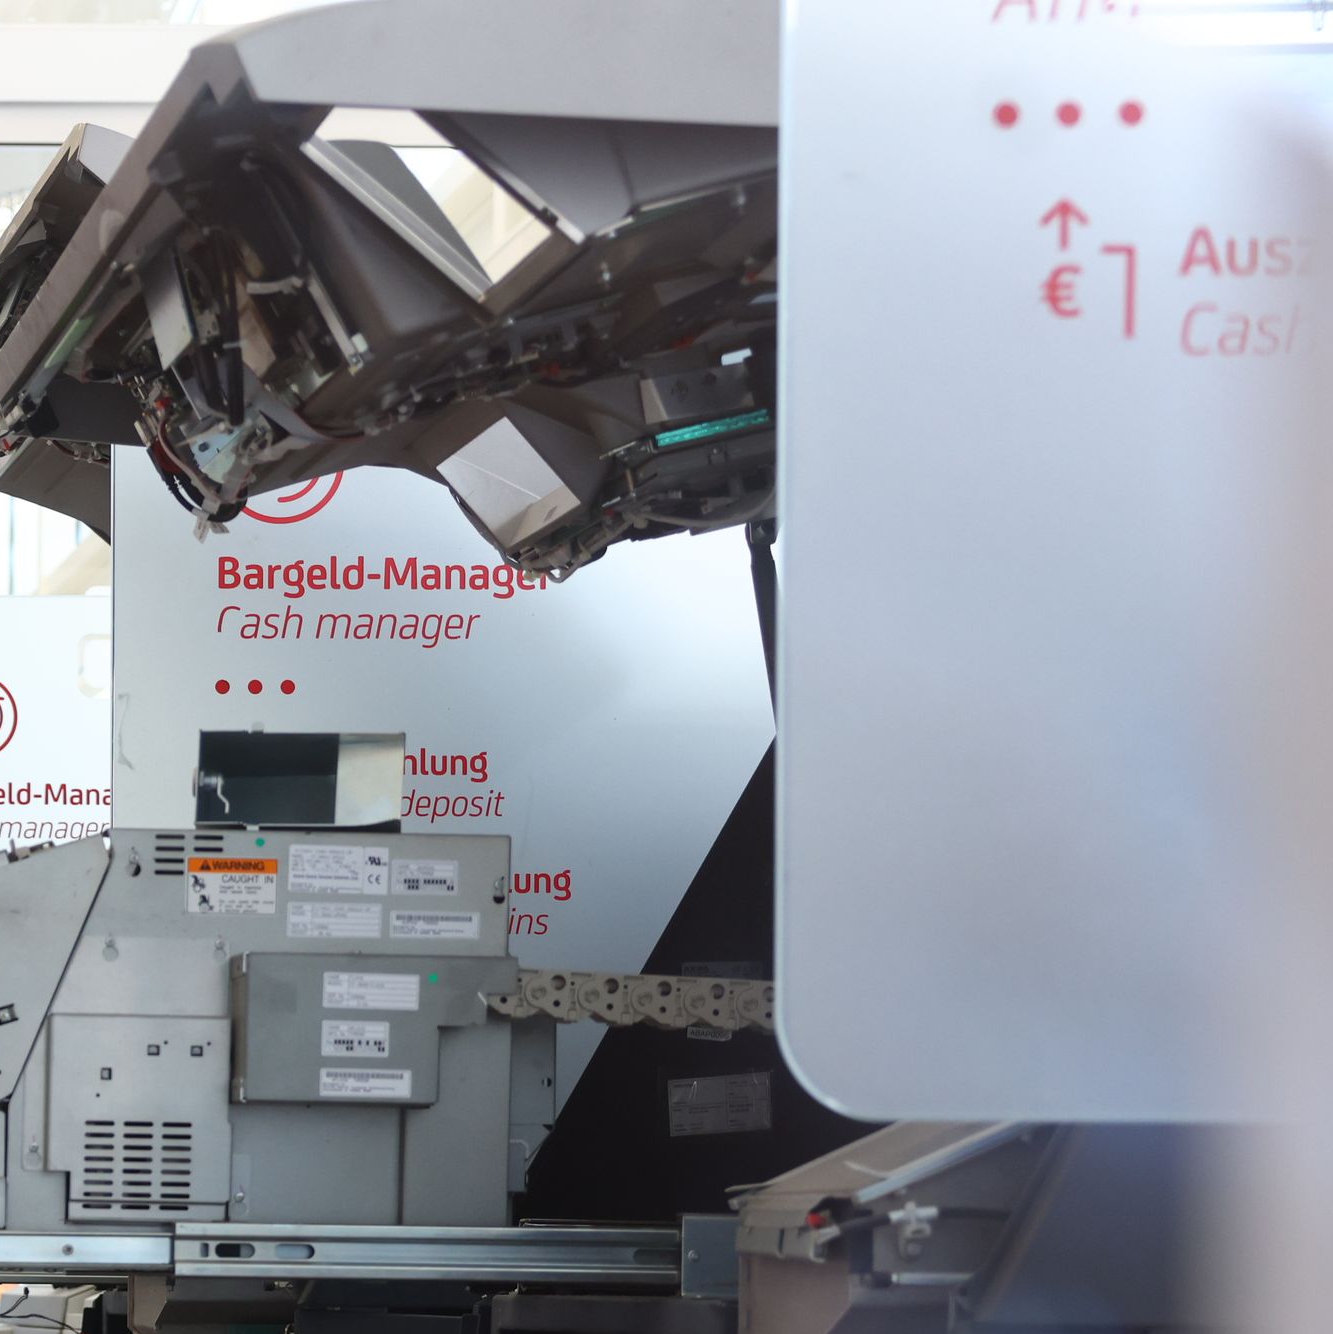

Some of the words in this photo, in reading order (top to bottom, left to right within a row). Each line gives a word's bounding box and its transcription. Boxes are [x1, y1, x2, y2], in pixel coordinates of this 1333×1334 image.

[316, 613, 480, 648] manager
[401, 789, 505, 823] deposit
[213, 860, 265, 871] WARNING
[221, 874, 259, 884] CAUGHT
[264, 875, 274, 884] IN
